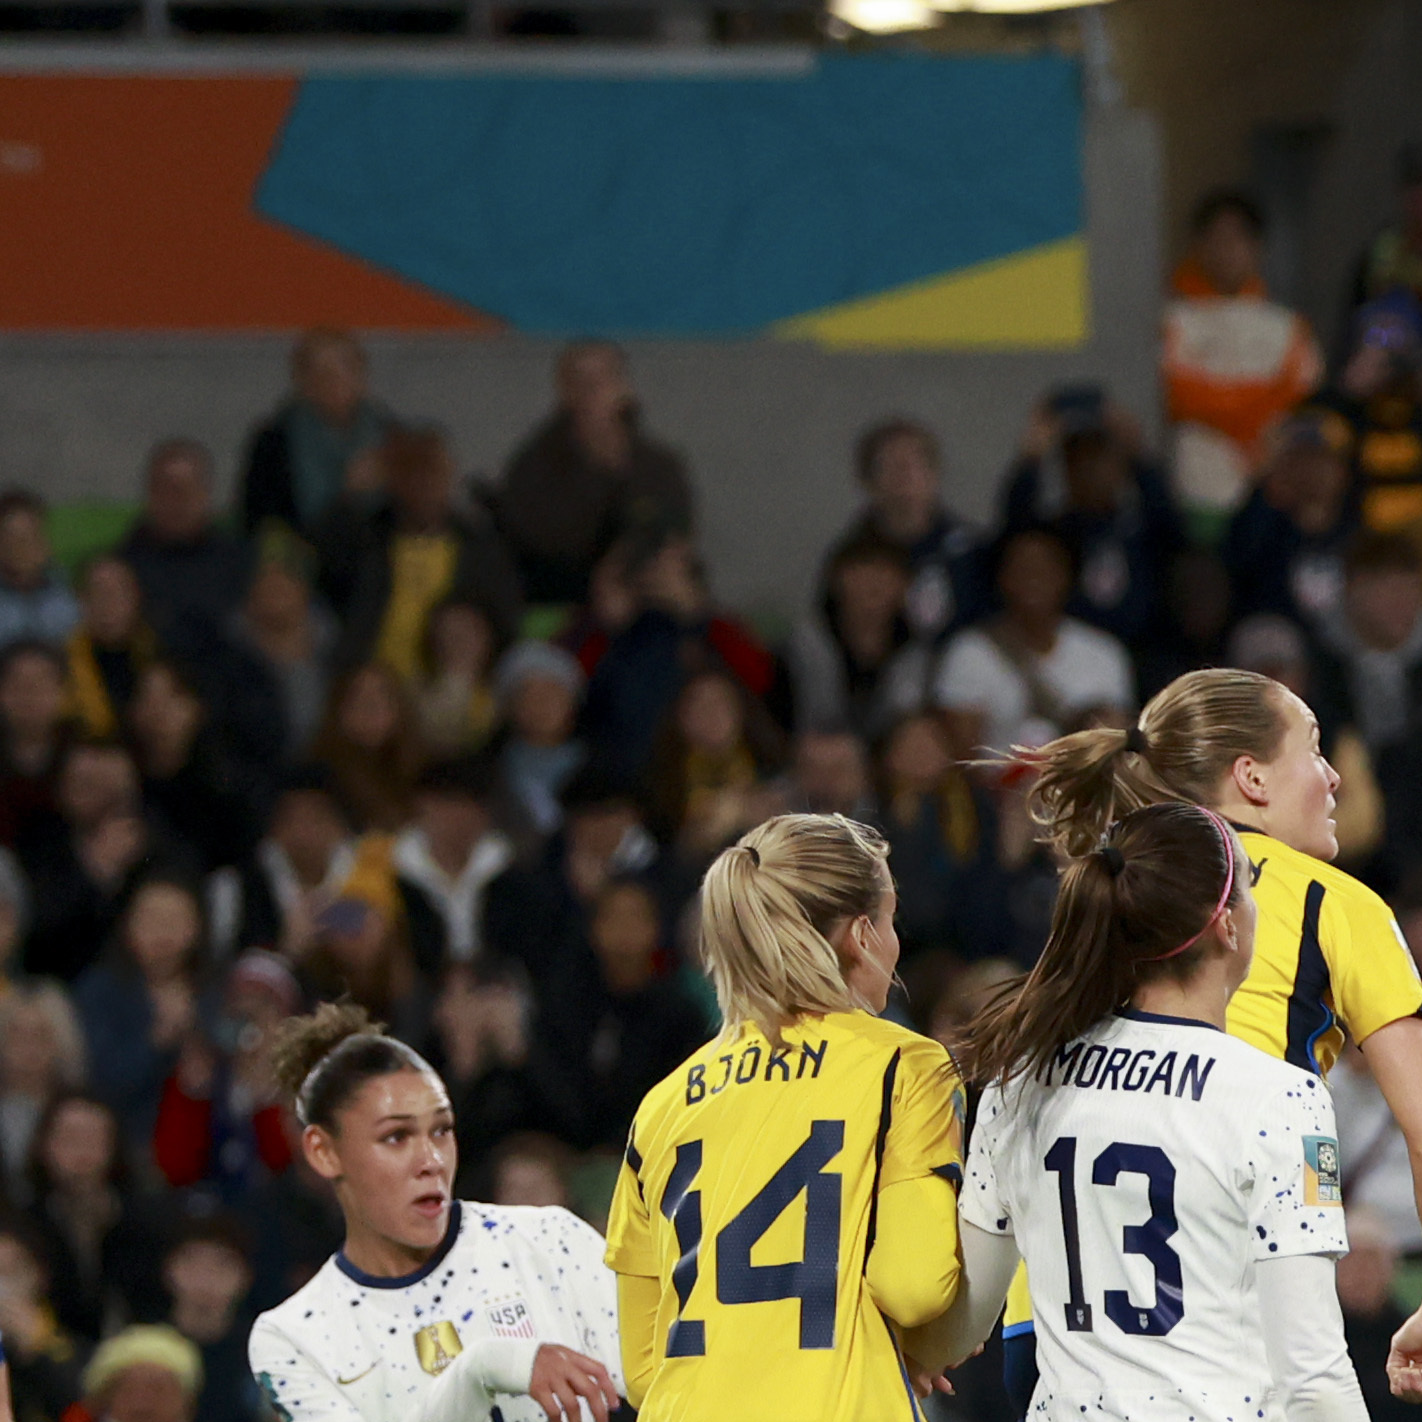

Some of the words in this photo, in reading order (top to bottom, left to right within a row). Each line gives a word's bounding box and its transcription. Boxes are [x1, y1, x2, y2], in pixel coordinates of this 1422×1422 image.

[1043, 1042, 1217, 1102] MORGAN
[660, 1119, 845, 1358] 14
[1044, 1136, 1185, 1337] 13
[490, 1303, 526, 1326] USA
